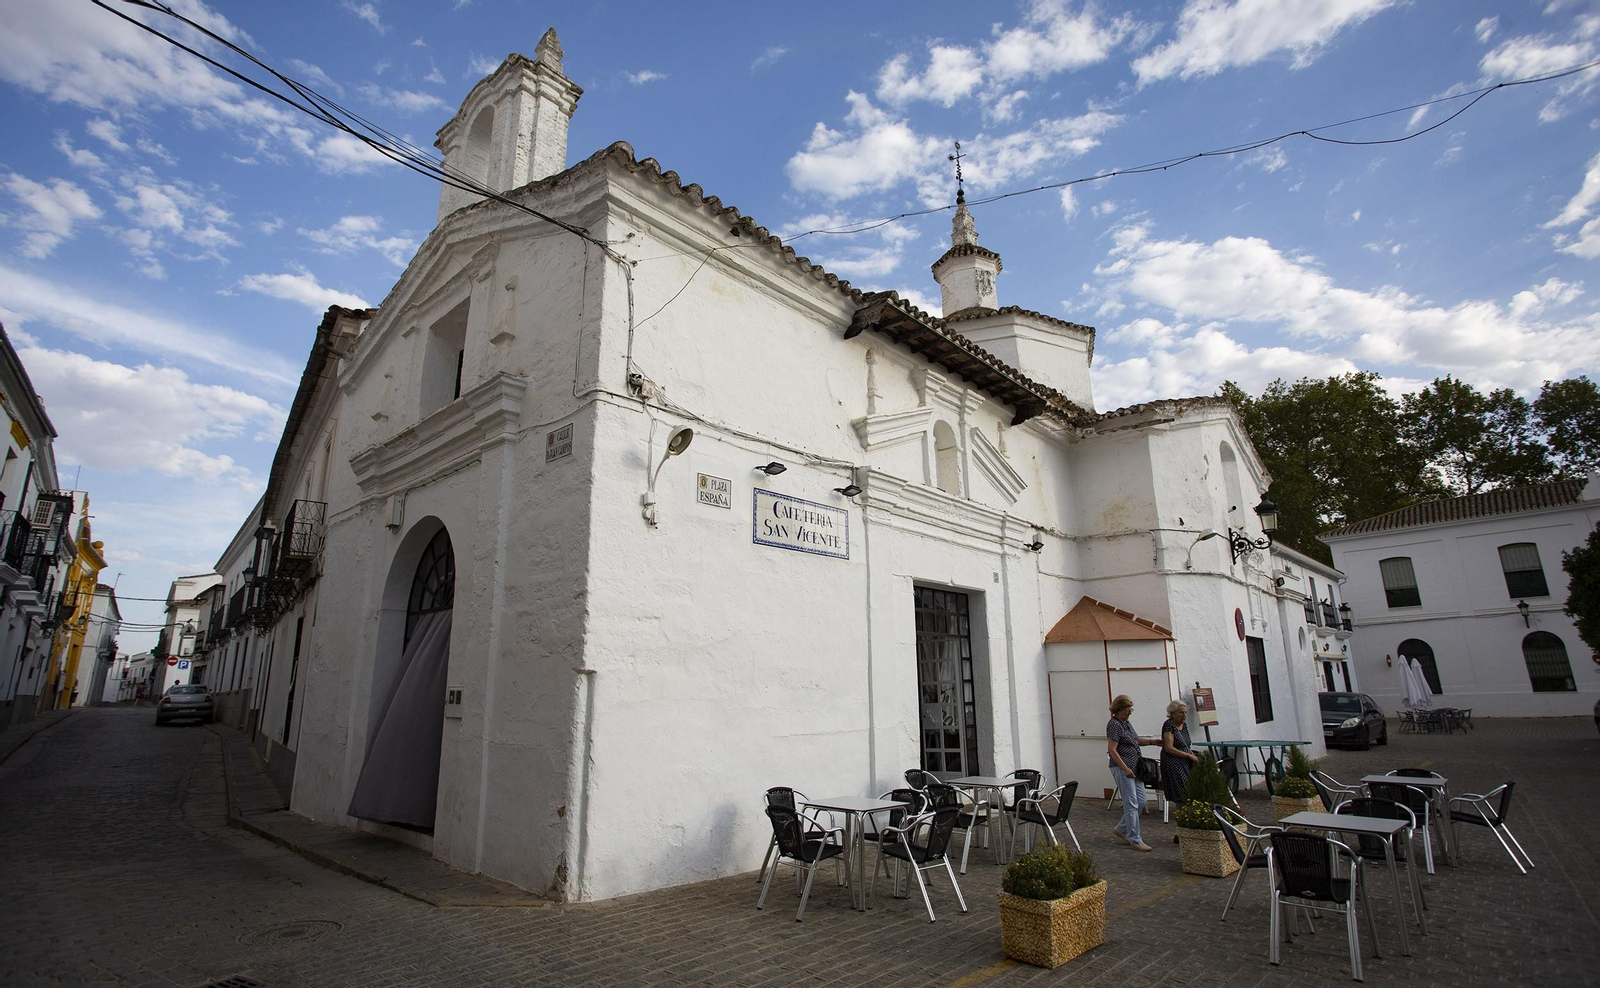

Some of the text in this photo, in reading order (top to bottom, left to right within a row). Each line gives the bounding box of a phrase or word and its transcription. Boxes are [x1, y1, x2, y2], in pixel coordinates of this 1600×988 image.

[711, 480, 728, 493] PLAZA
[700, 491, 728, 506] ESPAÑA
[764, 519, 789, 538] SAN
